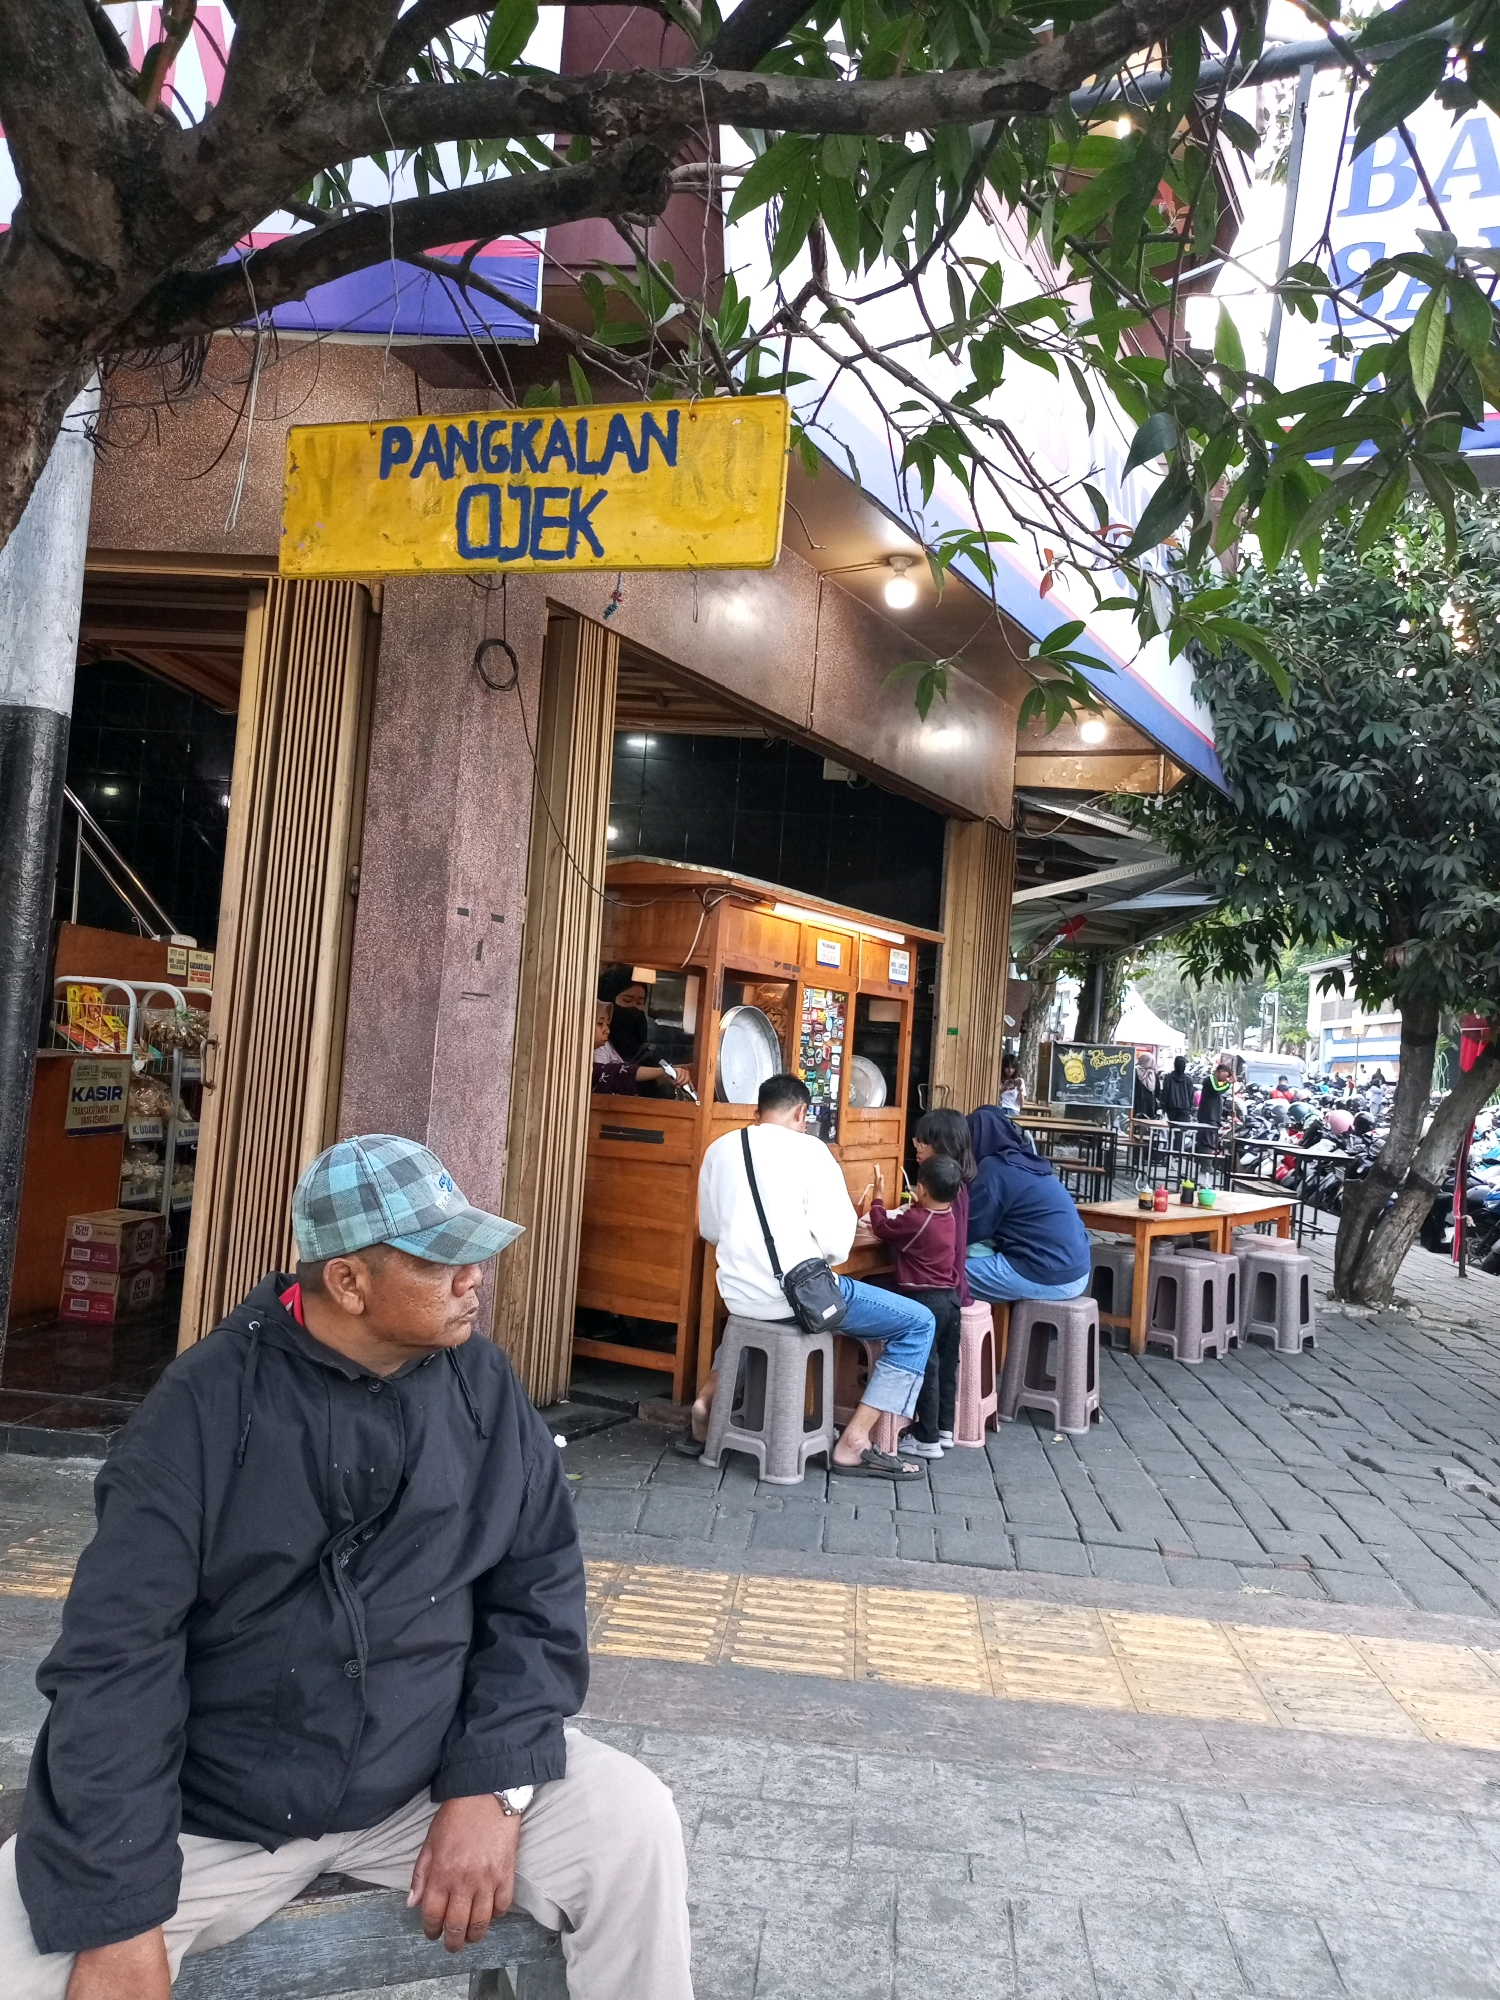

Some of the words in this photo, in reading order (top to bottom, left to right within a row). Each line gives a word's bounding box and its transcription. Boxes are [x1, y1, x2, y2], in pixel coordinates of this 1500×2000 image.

[380, 409, 680, 480] PANGKALAN
[455, 482, 609, 563] OJEK
[71, 1086, 123, 1102] KASIR
[75, 1224, 89, 1232] ICHI
[138, 1229, 153, 1241] ICHI
[135, 1240, 152, 1252] OCHA
[134, 1277, 151, 1291] ICHI
